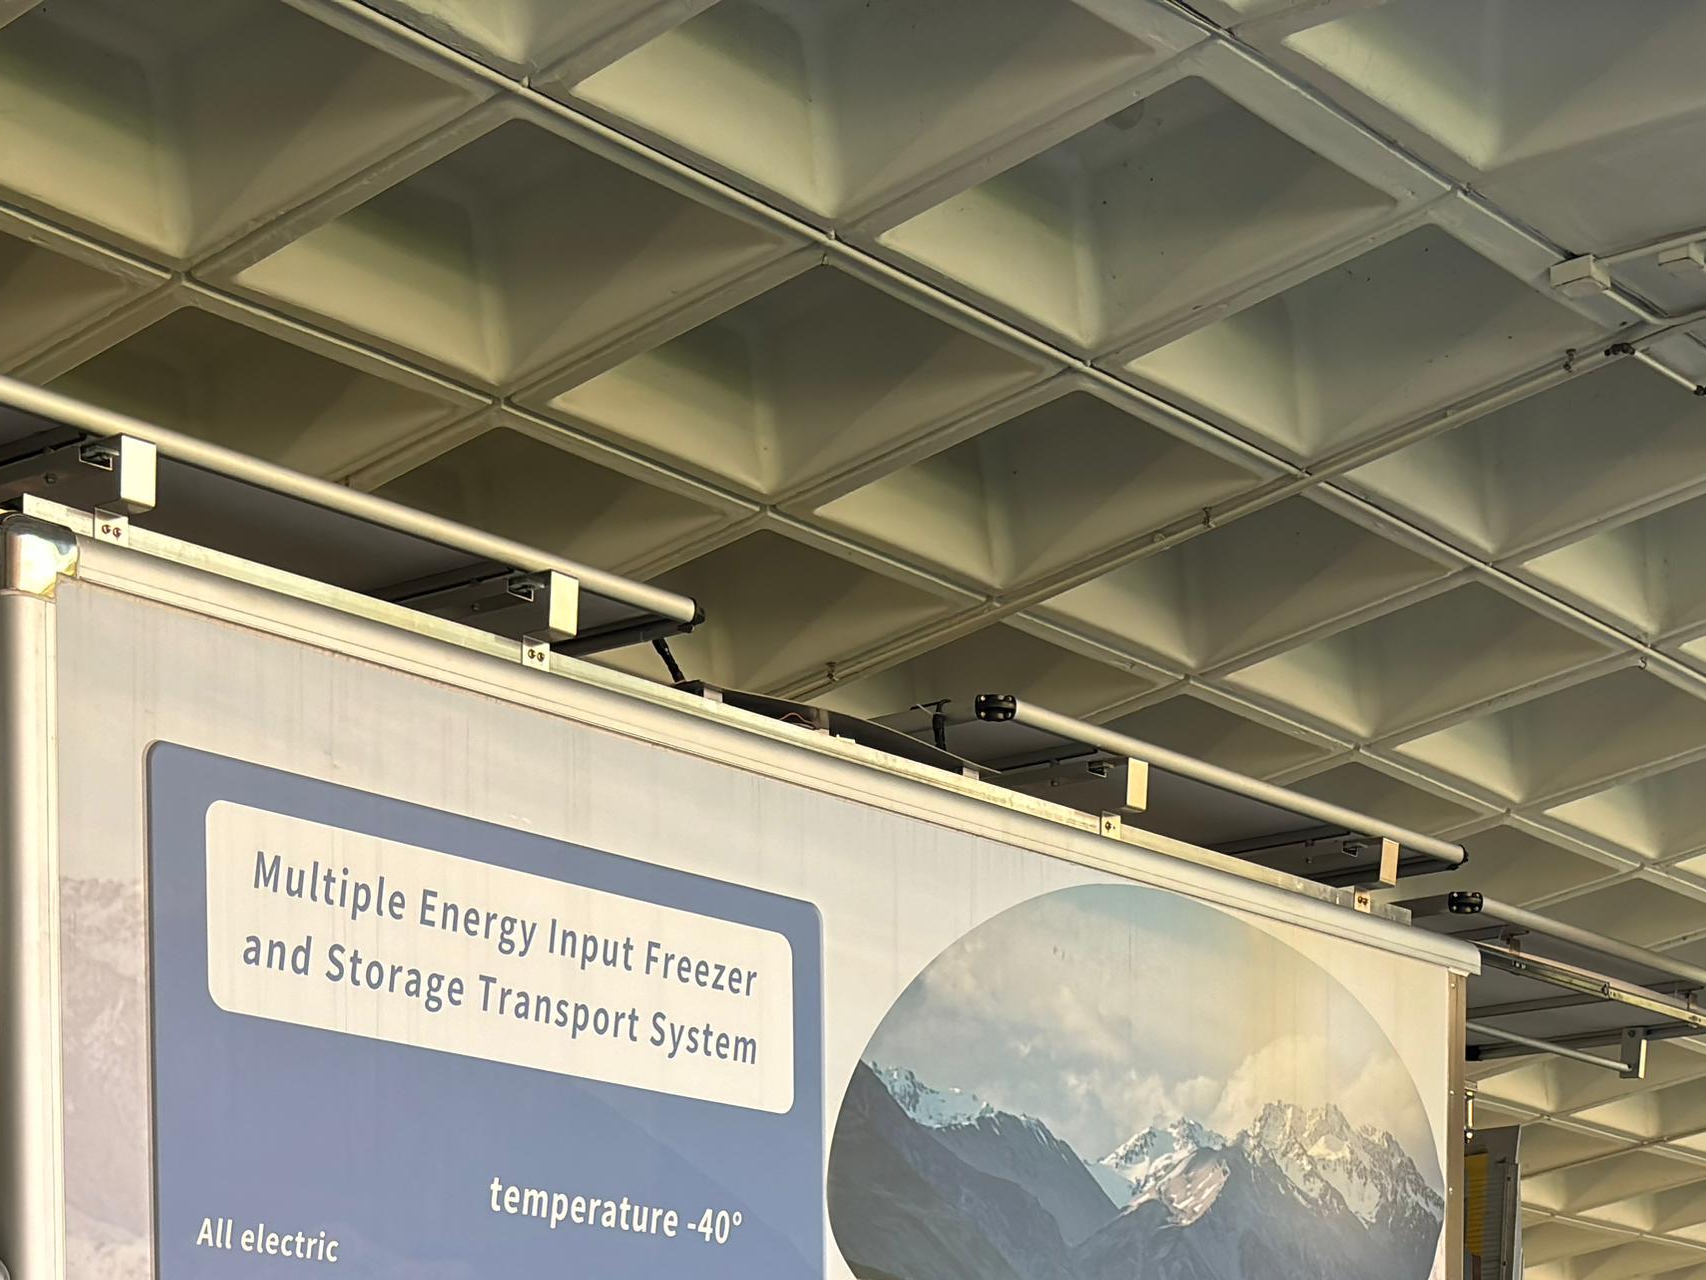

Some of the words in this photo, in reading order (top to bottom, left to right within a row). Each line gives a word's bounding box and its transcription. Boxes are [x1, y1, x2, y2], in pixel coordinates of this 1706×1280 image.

[253, 850, 406, 921] Multiple
[419, 890, 536, 957] Energy
[548, 917, 635, 970] Input
[644, 941, 758, 997] Freezer
[242, 934, 312, 976] and
[325, 943, 464, 1012] Storage
[478, 974, 639, 1040] Transport
[650, 1012, 758, 1065] System
[197, 1217, 233, 1255] All
[240, 1223, 339, 1264] electric
[489, 1176, 679, 1238] temperature
